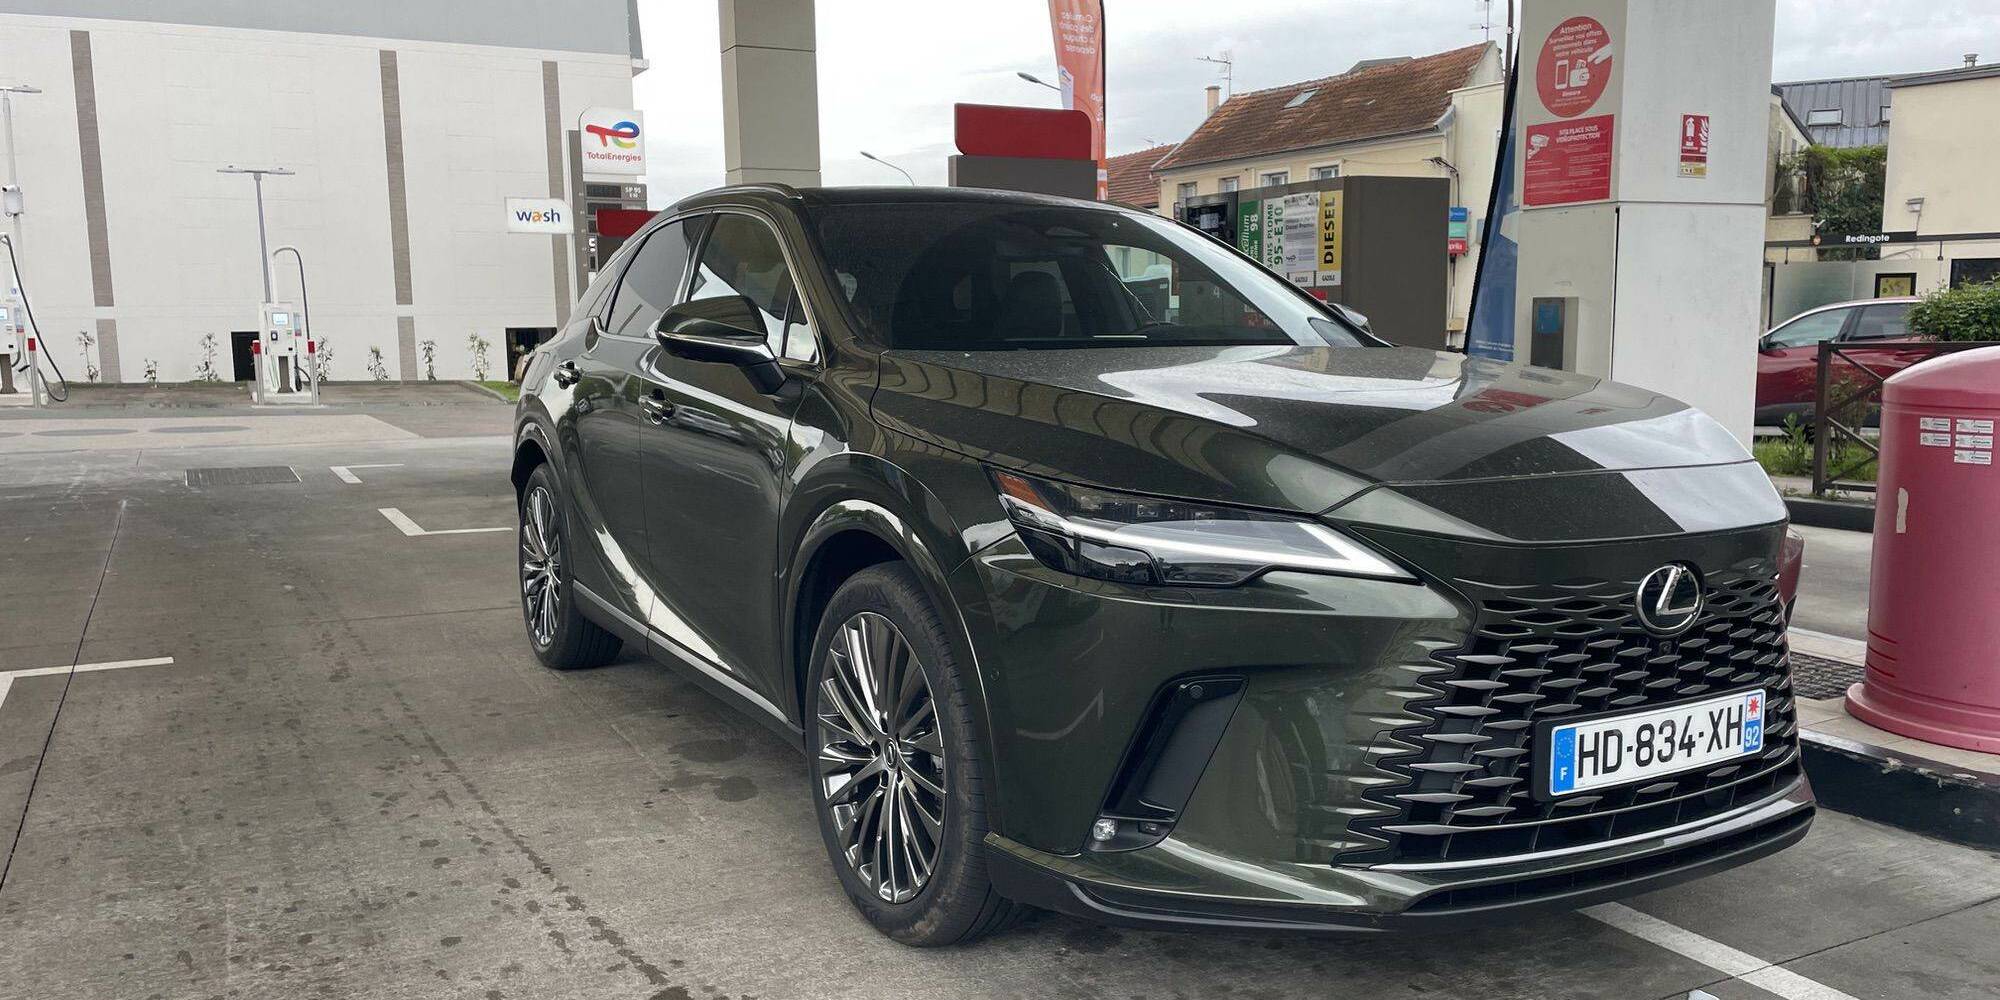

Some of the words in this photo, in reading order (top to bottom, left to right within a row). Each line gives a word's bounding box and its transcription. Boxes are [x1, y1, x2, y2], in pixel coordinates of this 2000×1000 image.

[1560, 23, 1592, 34] Attention
[587, 151, 642, 163] TotalEnergies
[516, 207, 561, 223] wash
[1250, 213, 1259, 231] 98
[1274, 207, 1284, 265] 95-E10
[1323, 197, 1336, 264] DIESEL
[1845, 234, 1890, 244] Redingote
[1578, 704, 1743, 779] HD-834-XH
[1745, 726, 1759, 747] 92
[1560, 767, 1568, 781] F
